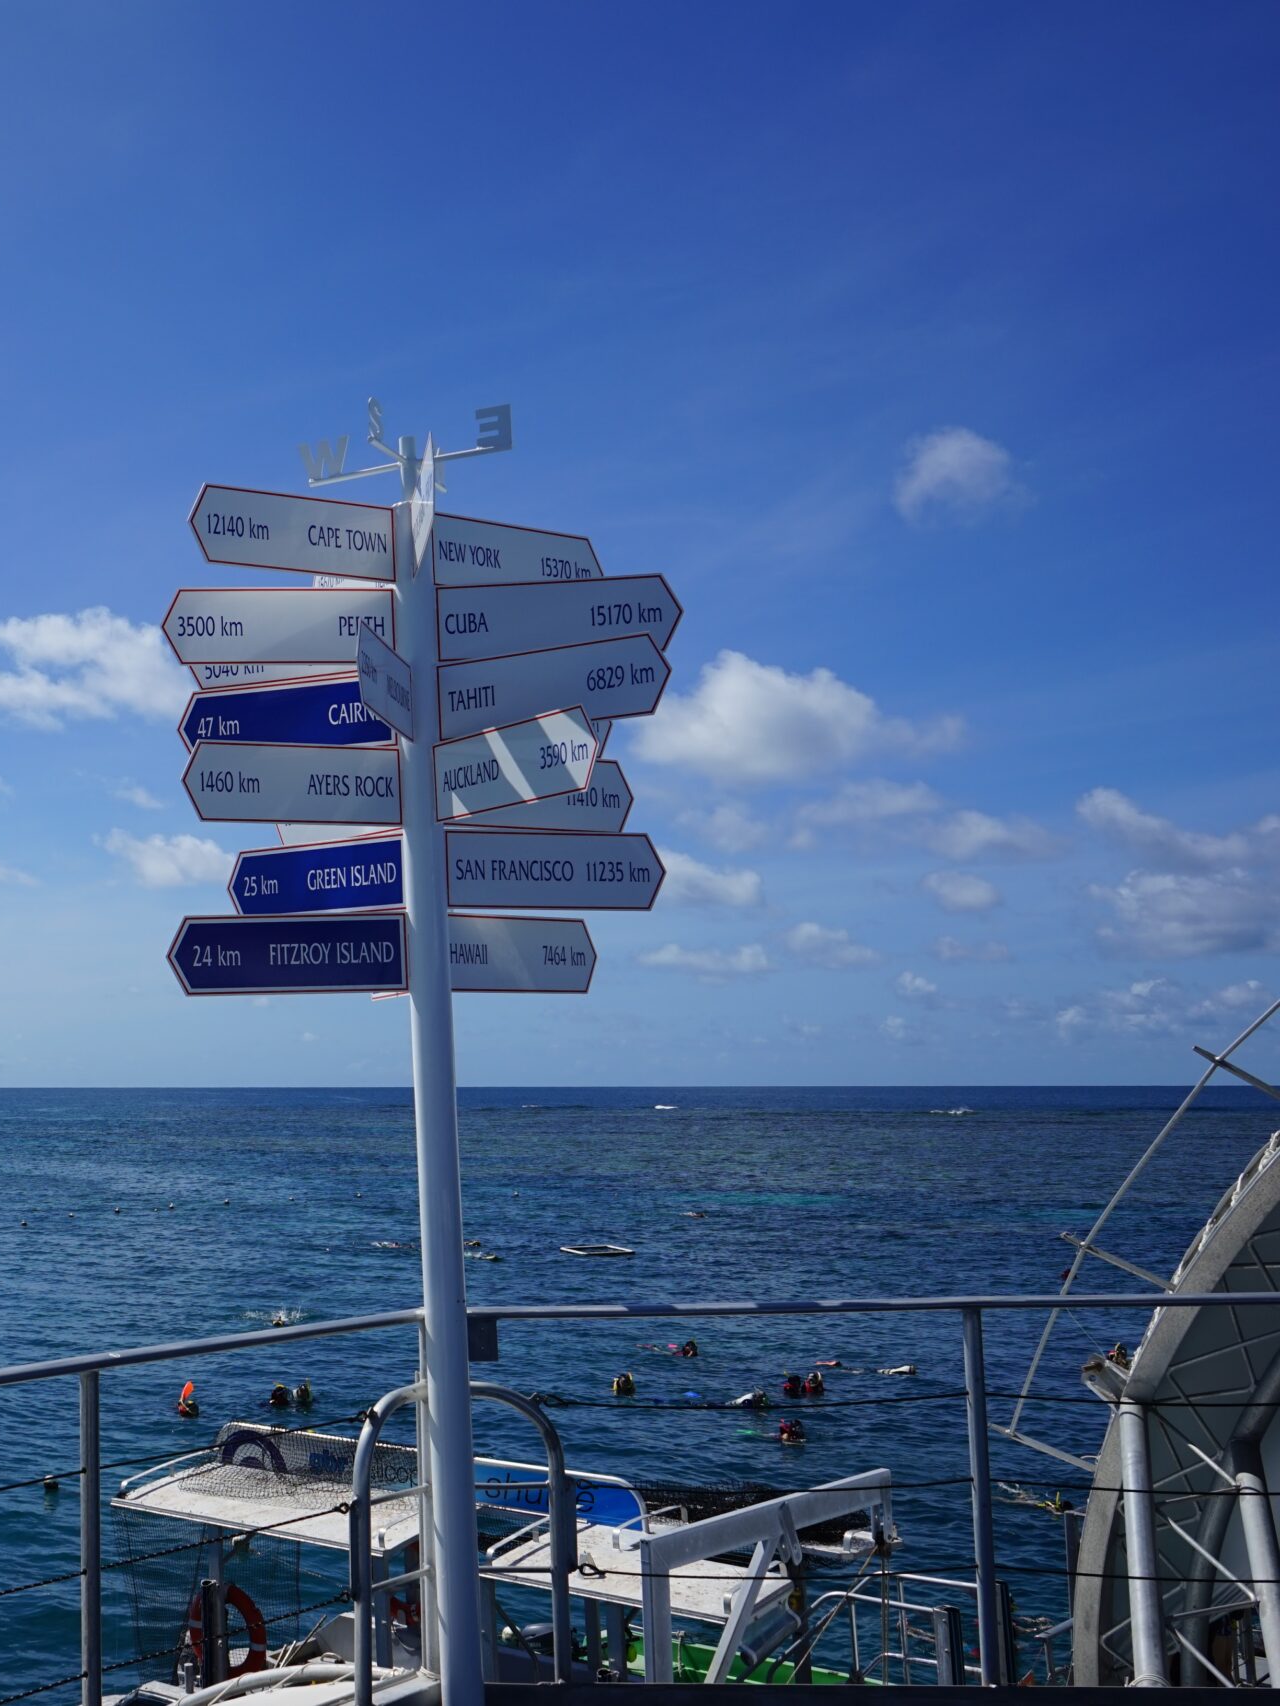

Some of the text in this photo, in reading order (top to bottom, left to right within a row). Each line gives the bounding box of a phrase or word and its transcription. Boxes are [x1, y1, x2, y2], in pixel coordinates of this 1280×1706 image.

[207, 513, 387, 555] 12140 km CAPE TOWN
[438, 540, 592, 579] NEW YORK 15370 km
[177, 615, 216, 637] 3500
[220, 615, 244, 637] km
[444, 602, 663, 635] CUBA 15170 km
[447, 661, 655, 713] TAHITI 6829 km
[197, 702, 382, 738] 47 km CAIRN
[442, 739, 589, 793] AUCKLAND 3590 km
[200, 770, 394, 798] 1460 km AYERS ROCK
[601, 788, 620, 809] km
[243, 862, 397, 897] 25 km GREEN ISLAND
[455, 858, 651, 883] SAN FRANCISCO 11235 km
[192, 941, 395, 967] 24 km FITZROY ISLAND
[449, 943, 586, 967] HAWAII 7464 km
[484, 1472, 595, 1513] shue
